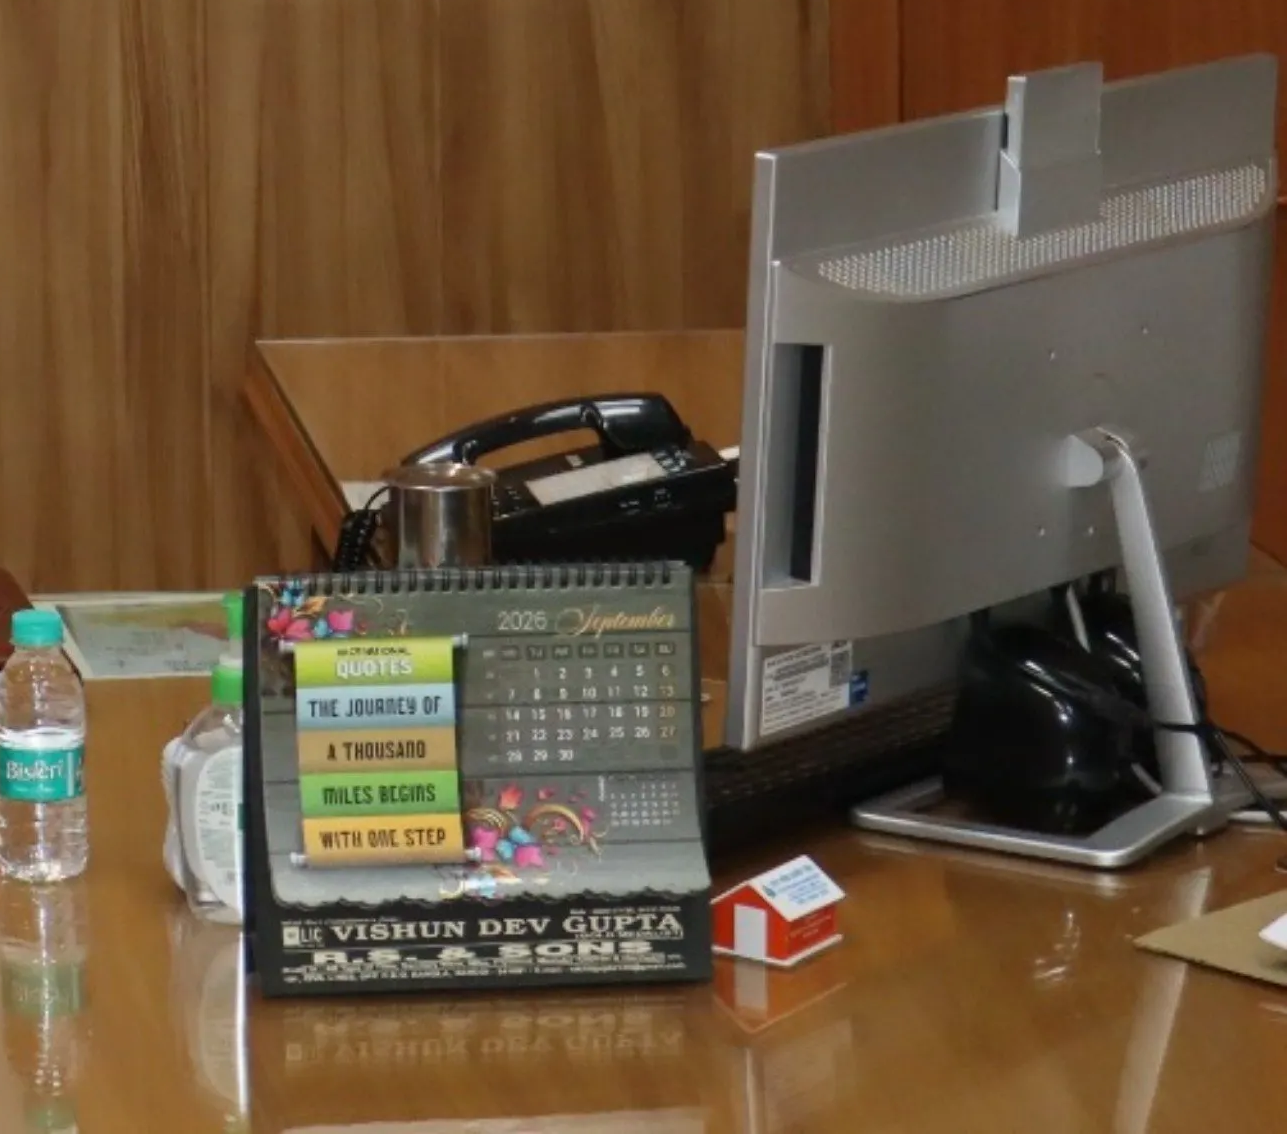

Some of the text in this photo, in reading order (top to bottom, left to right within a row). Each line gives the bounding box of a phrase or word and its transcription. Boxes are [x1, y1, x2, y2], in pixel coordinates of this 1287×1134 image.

[497, 604, 675, 639] 2026 September
[336, 660, 413, 678] QUOTES
[534, 665, 670, 679] 1 2 3 4 5 6
[508, 685, 674, 700] 7 8 9 10 11 12 13
[308, 696, 441, 717] THE JOURNEY OF
[506, 706, 675, 721] 14 15 16 17 18 19 20
[506, 726, 675, 742] 21 22 23 24 25 26 27
[327, 740, 427, 761] A THOUSAND
[507, 749, 574, 763] 28 29 30
[322, 783, 436, 806] MILES BEGINS
[319, 828, 446, 850] WITH ONE STEP
[332, 921, 467, 941] VISHUN
[478, 918, 551, 937] DEV
[562, 913, 681, 934] GUPTA
[499, 941, 653, 959] SONS
